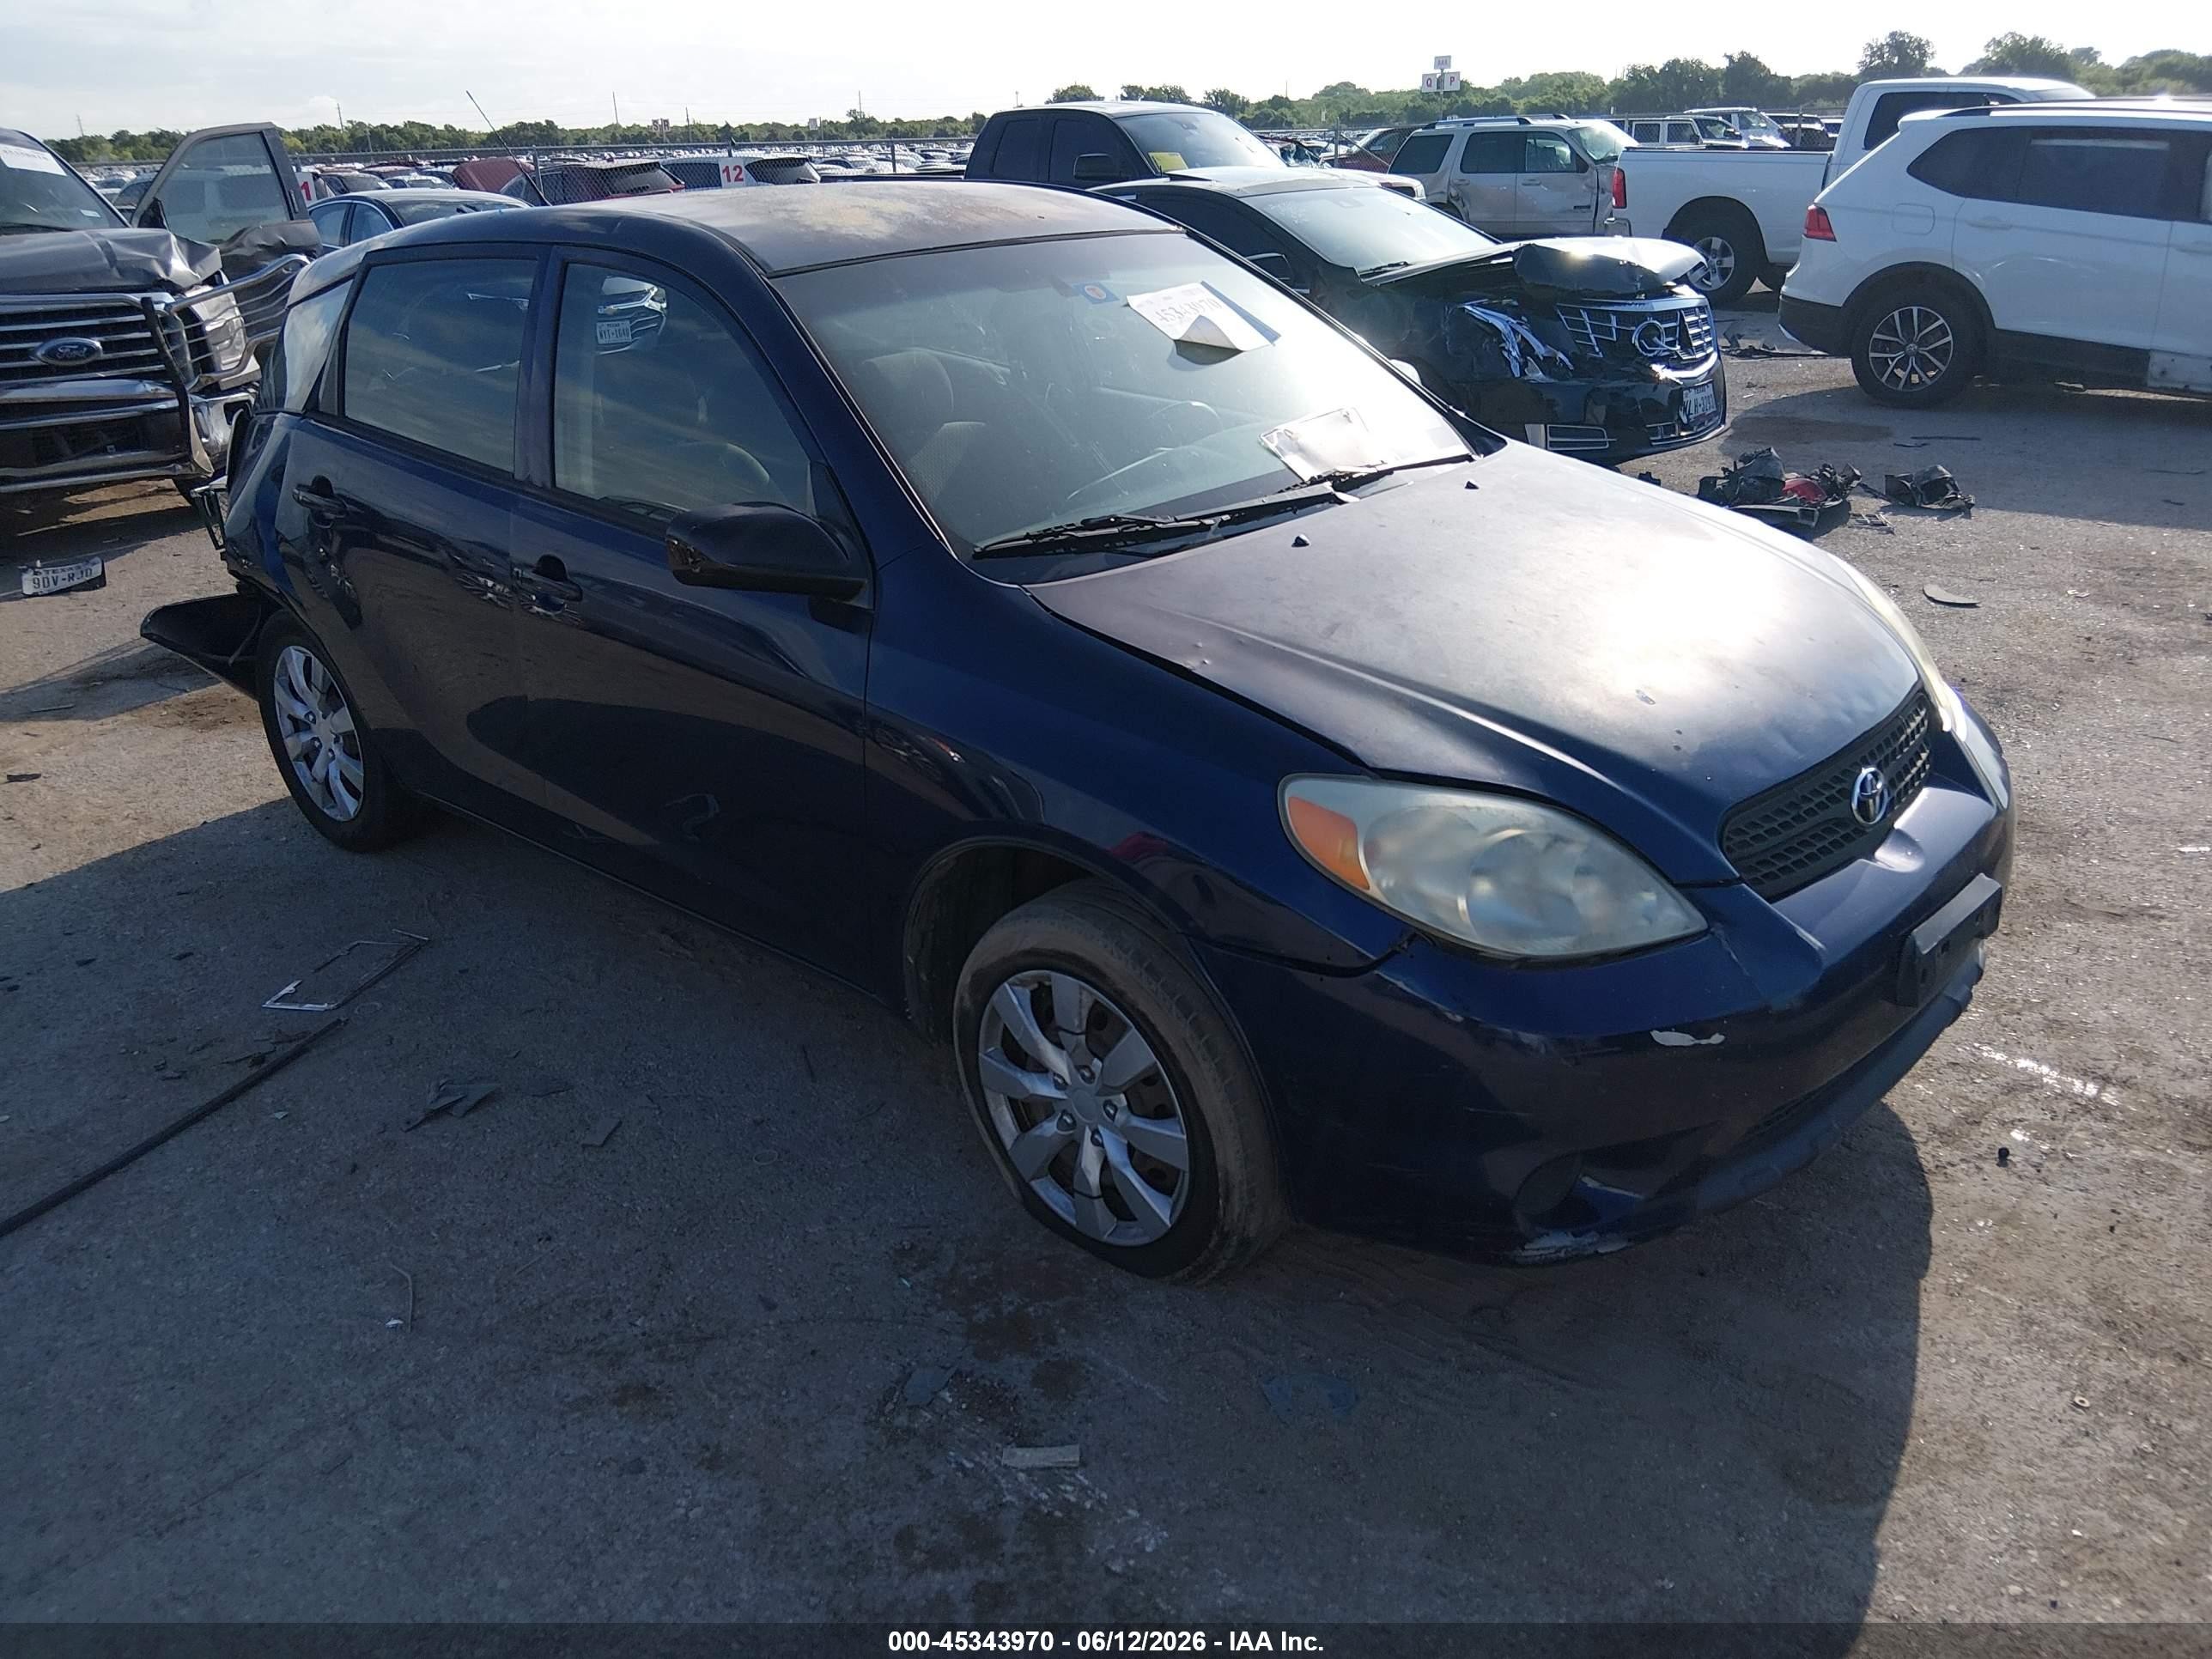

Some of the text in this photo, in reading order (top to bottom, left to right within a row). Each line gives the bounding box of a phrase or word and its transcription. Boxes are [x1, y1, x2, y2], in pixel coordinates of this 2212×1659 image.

[1426, 77, 1432, 88] Q
[1449, 76, 1455, 87] P
[653, 119, 659, 131] S
[663, 119, 670, 131] R
[722, 165, 744, 183] 12
